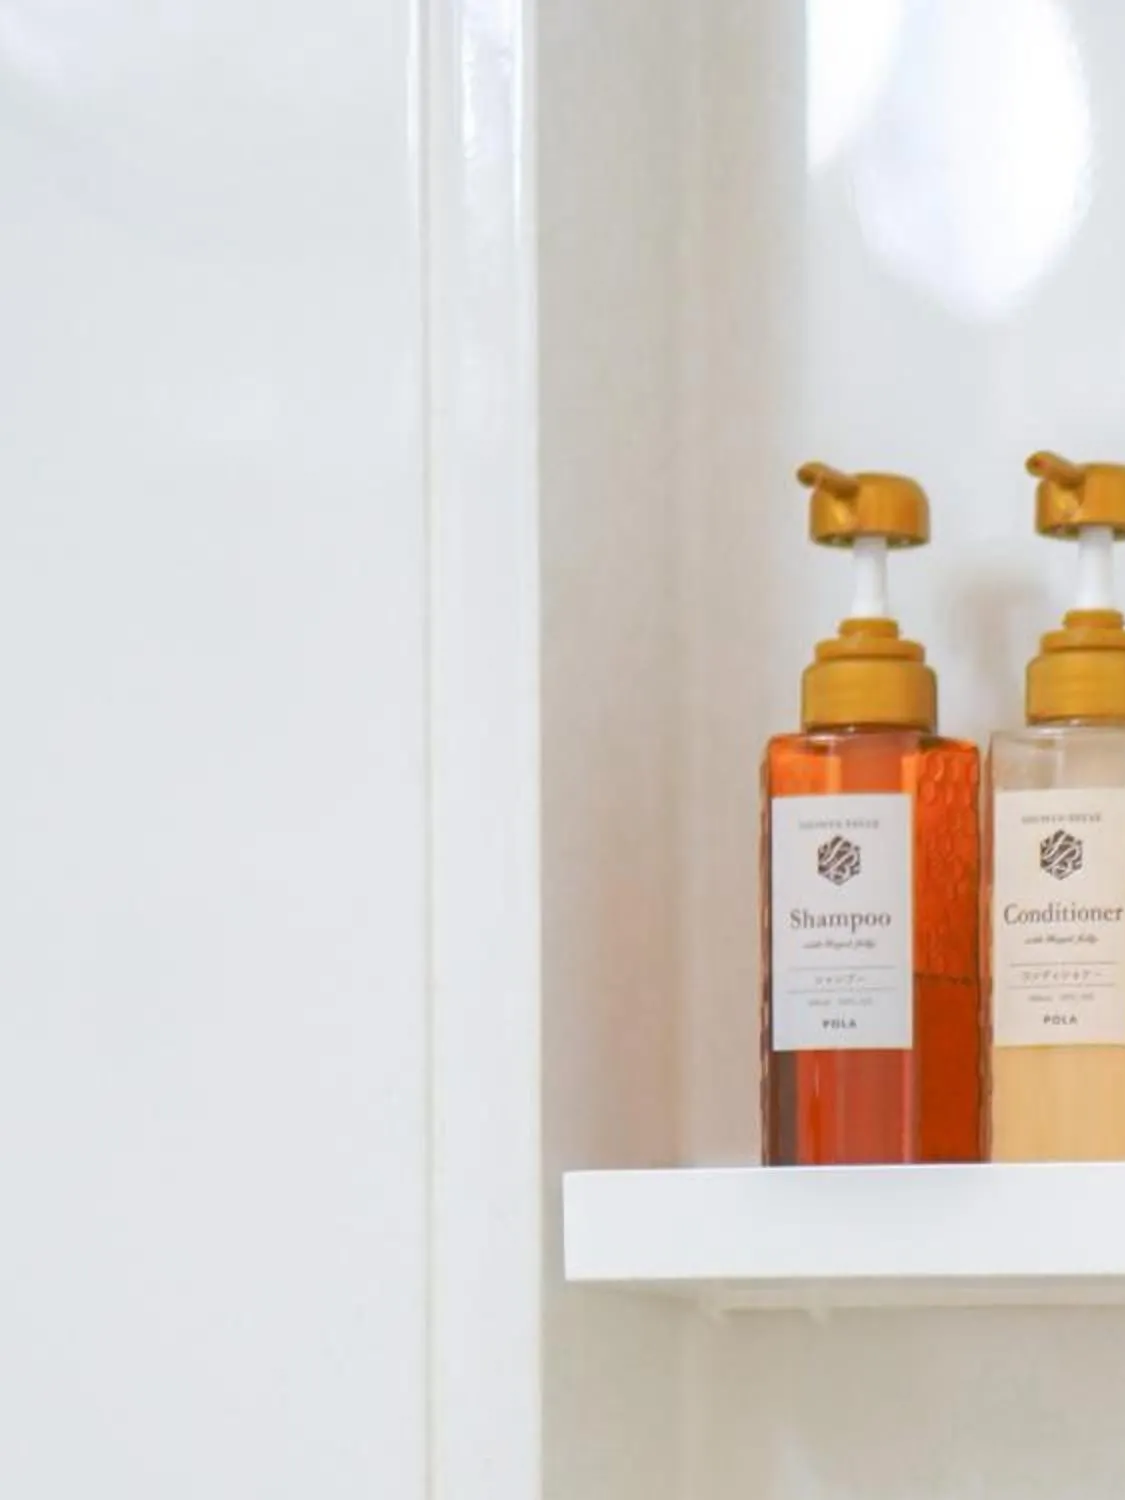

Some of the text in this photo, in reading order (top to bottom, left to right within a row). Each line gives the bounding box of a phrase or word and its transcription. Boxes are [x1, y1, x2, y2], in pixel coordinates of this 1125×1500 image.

[789, 908, 892, 933] Shampoo
[1003, 901, 1124, 925] Conditioner
[1042, 1014, 1078, 1025] POLA
